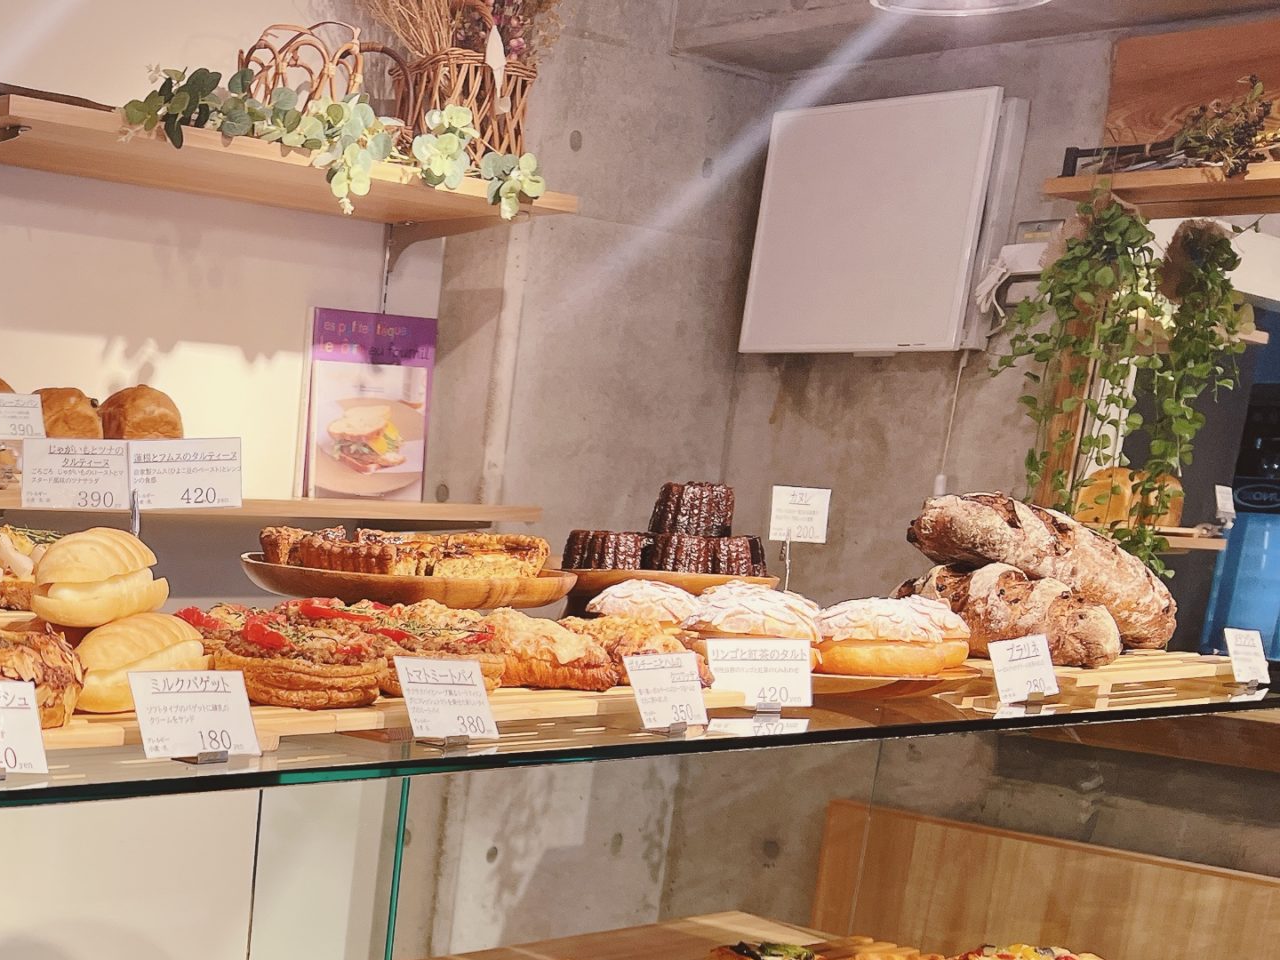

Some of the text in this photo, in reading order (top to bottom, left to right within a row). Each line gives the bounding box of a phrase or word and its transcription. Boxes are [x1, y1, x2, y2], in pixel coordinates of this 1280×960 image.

[10, 423, 34, 436] 390
[48, 444, 124, 455] じゃがいもとツナの
[62, 457, 110, 467] タルティーヌ
[78, 490, 114, 508] 390
[180, 487, 216, 504] 420
[796, 525, 814, 539] 200
[712, 648, 808, 661] リンゴと紅茶のタルト
[1006, 641, 1040, 660] プラリネ
[405, 667, 475, 685] トマトミートパイ
[1026, 677, 1046, 693] 280
[757, 686, 789, 703] 420
[671, 703, 694, 722] 350
[457, 715, 485, 734] 380
[199, 729, 232, 750] 180
